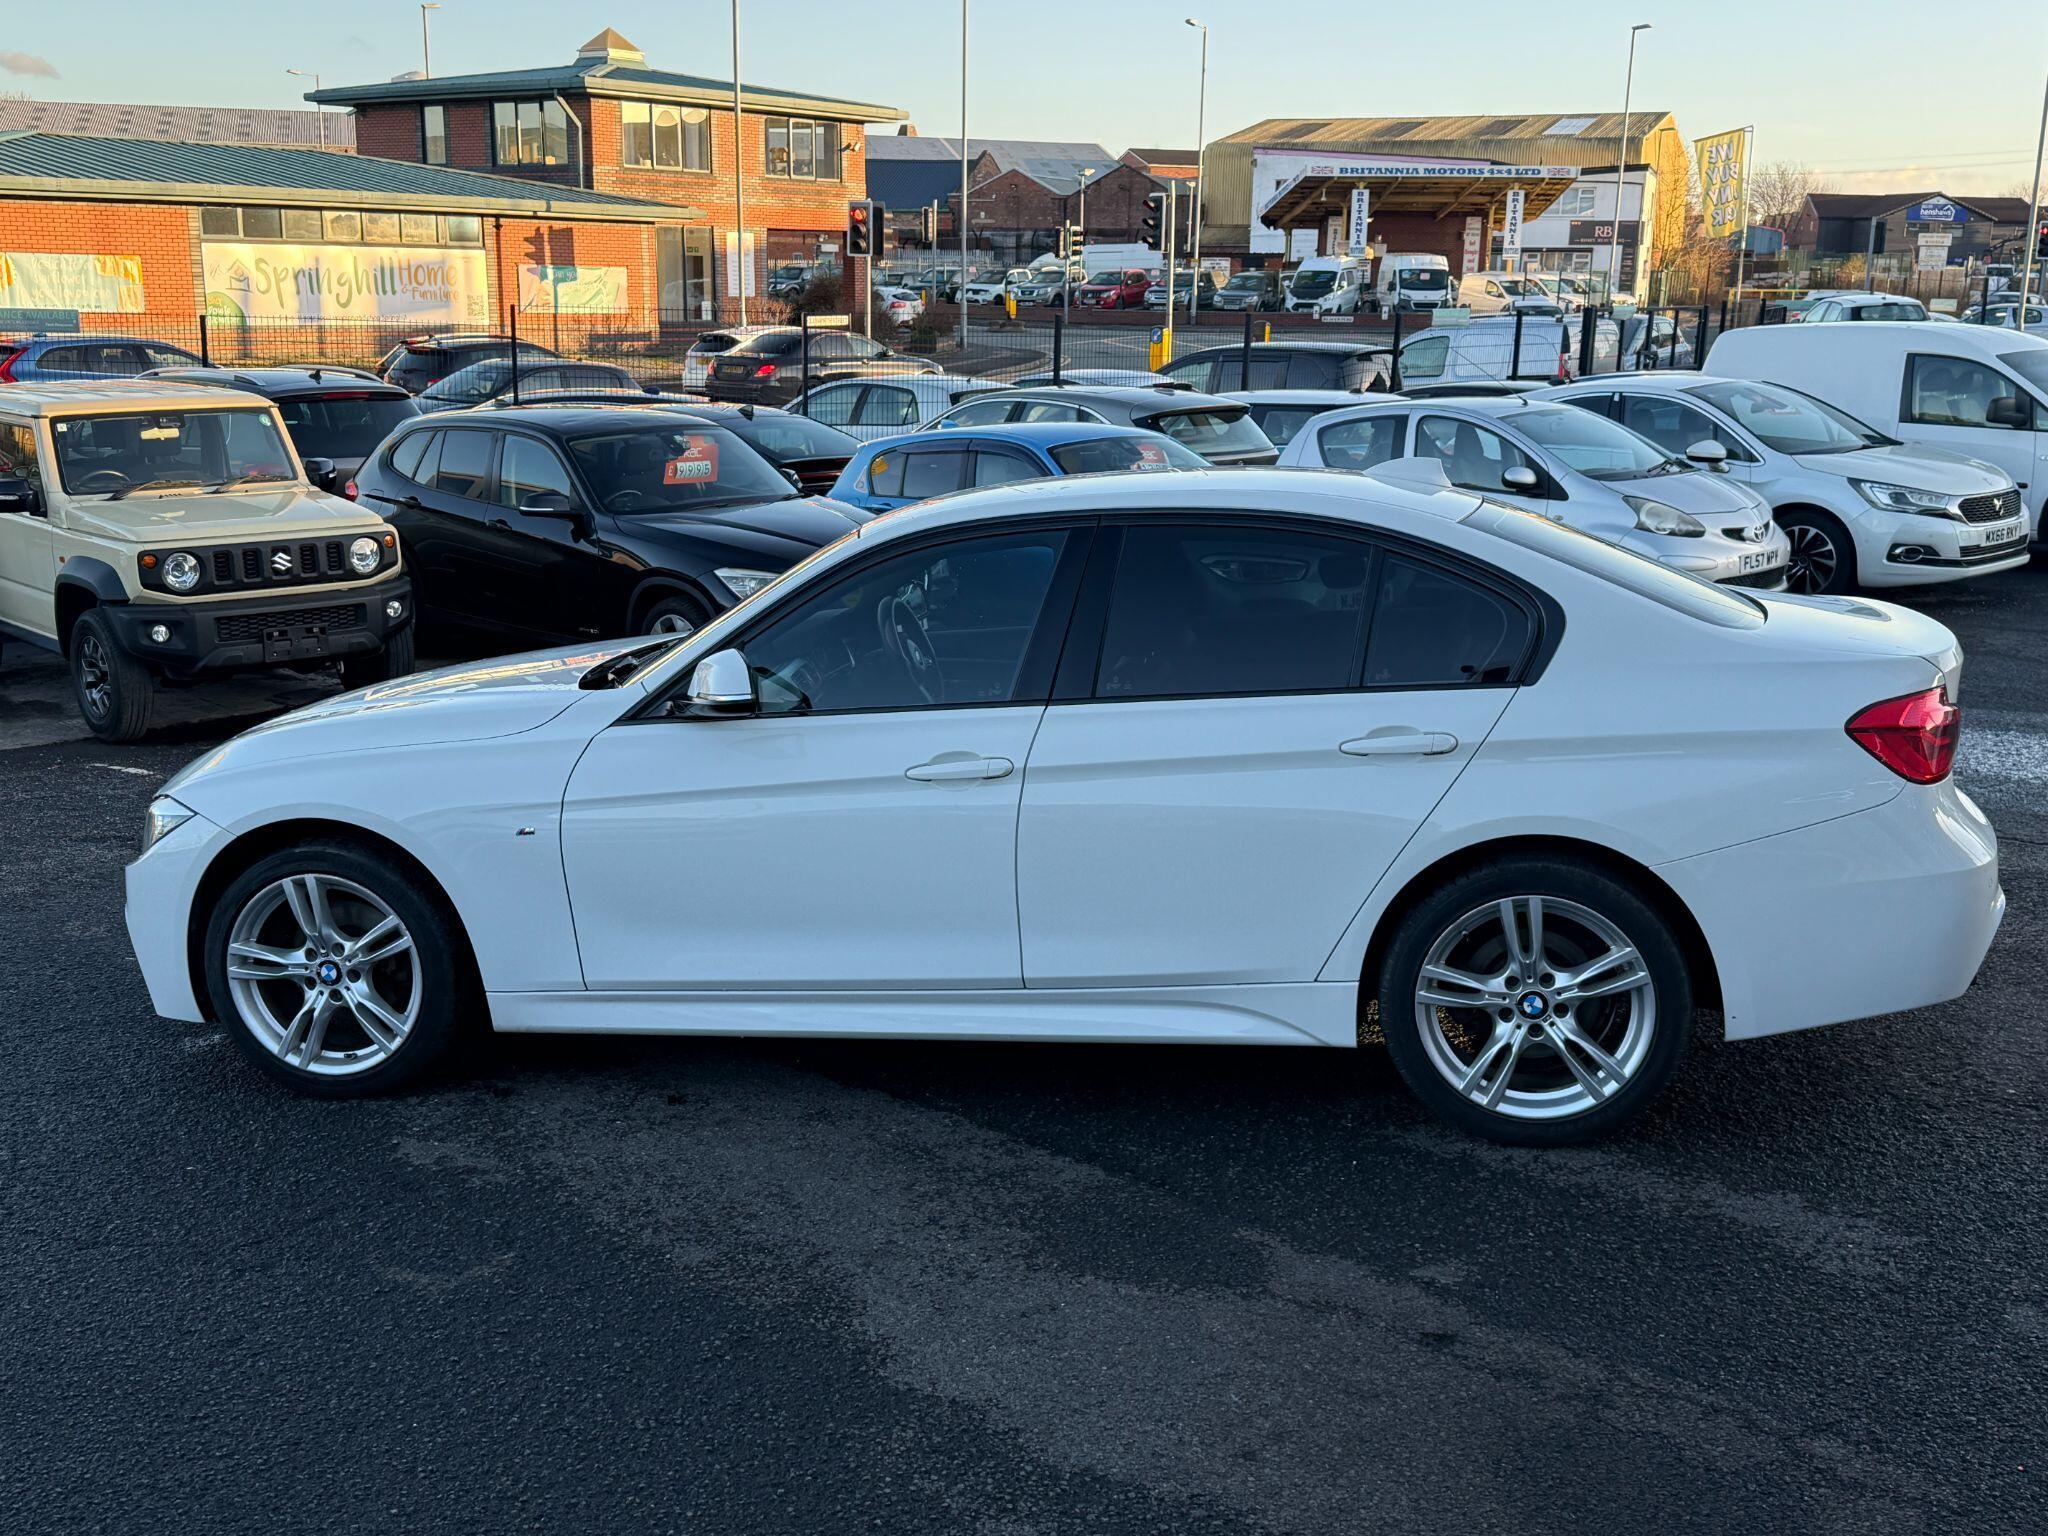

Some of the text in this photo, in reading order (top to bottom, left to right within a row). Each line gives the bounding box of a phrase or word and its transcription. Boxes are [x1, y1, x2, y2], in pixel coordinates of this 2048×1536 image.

[1338, 167, 1420, 176] BRITANNIA
[1423, 167, 1486, 176] MOTORS
[1515, 168, 1541, 176] LTD
[1508, 191, 1520, 246] BRITANNIA
[1594, 225, 1613, 237] RB
[255, 254, 458, 310] Springhill Home
[411, 286, 460, 301] Furniture
[25, 310, 77, 321] AVAILABLE
